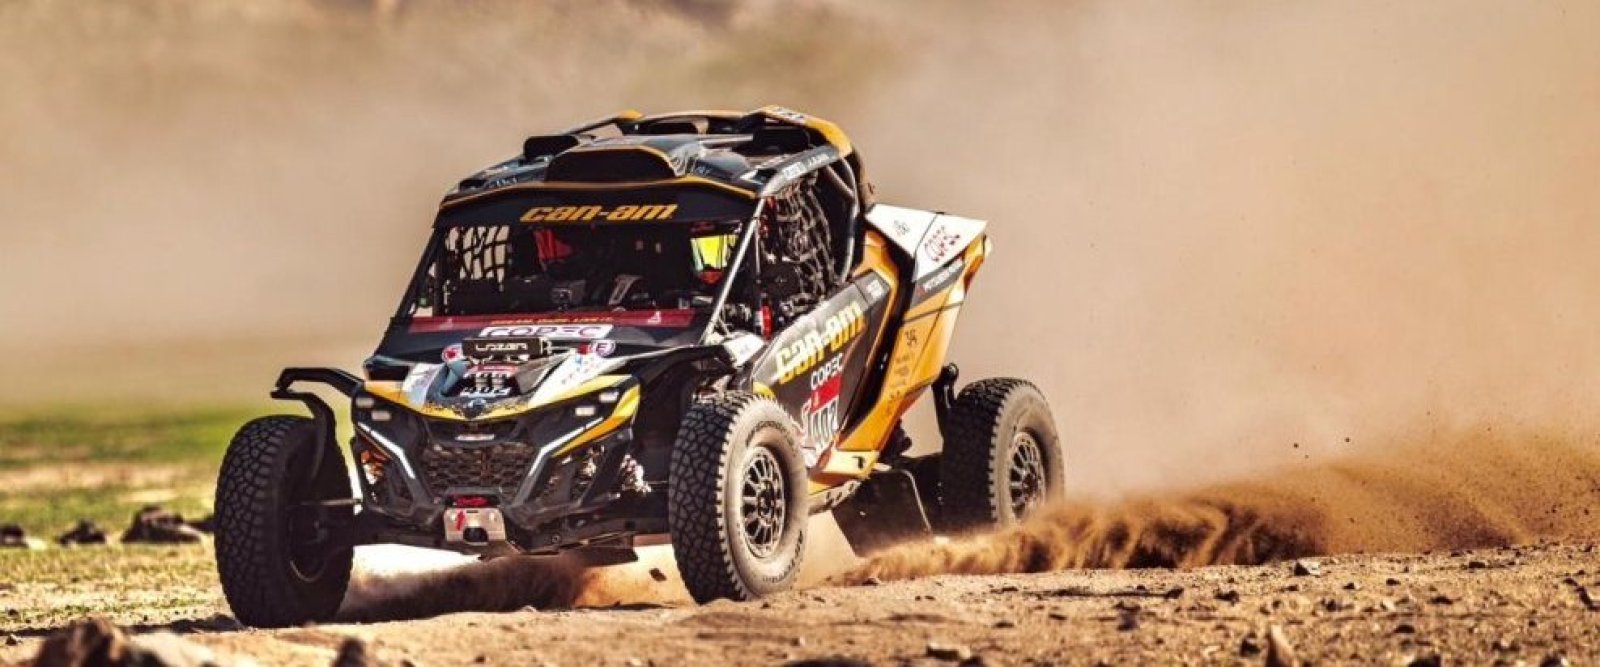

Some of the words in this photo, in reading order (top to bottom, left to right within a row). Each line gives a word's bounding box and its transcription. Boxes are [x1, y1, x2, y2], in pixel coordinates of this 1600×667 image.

[519, 204, 679, 223] can-am
[485, 325, 605, 338] COPEC
[777, 301, 867, 385] can-am
[810, 352, 843, 392] COPEC
